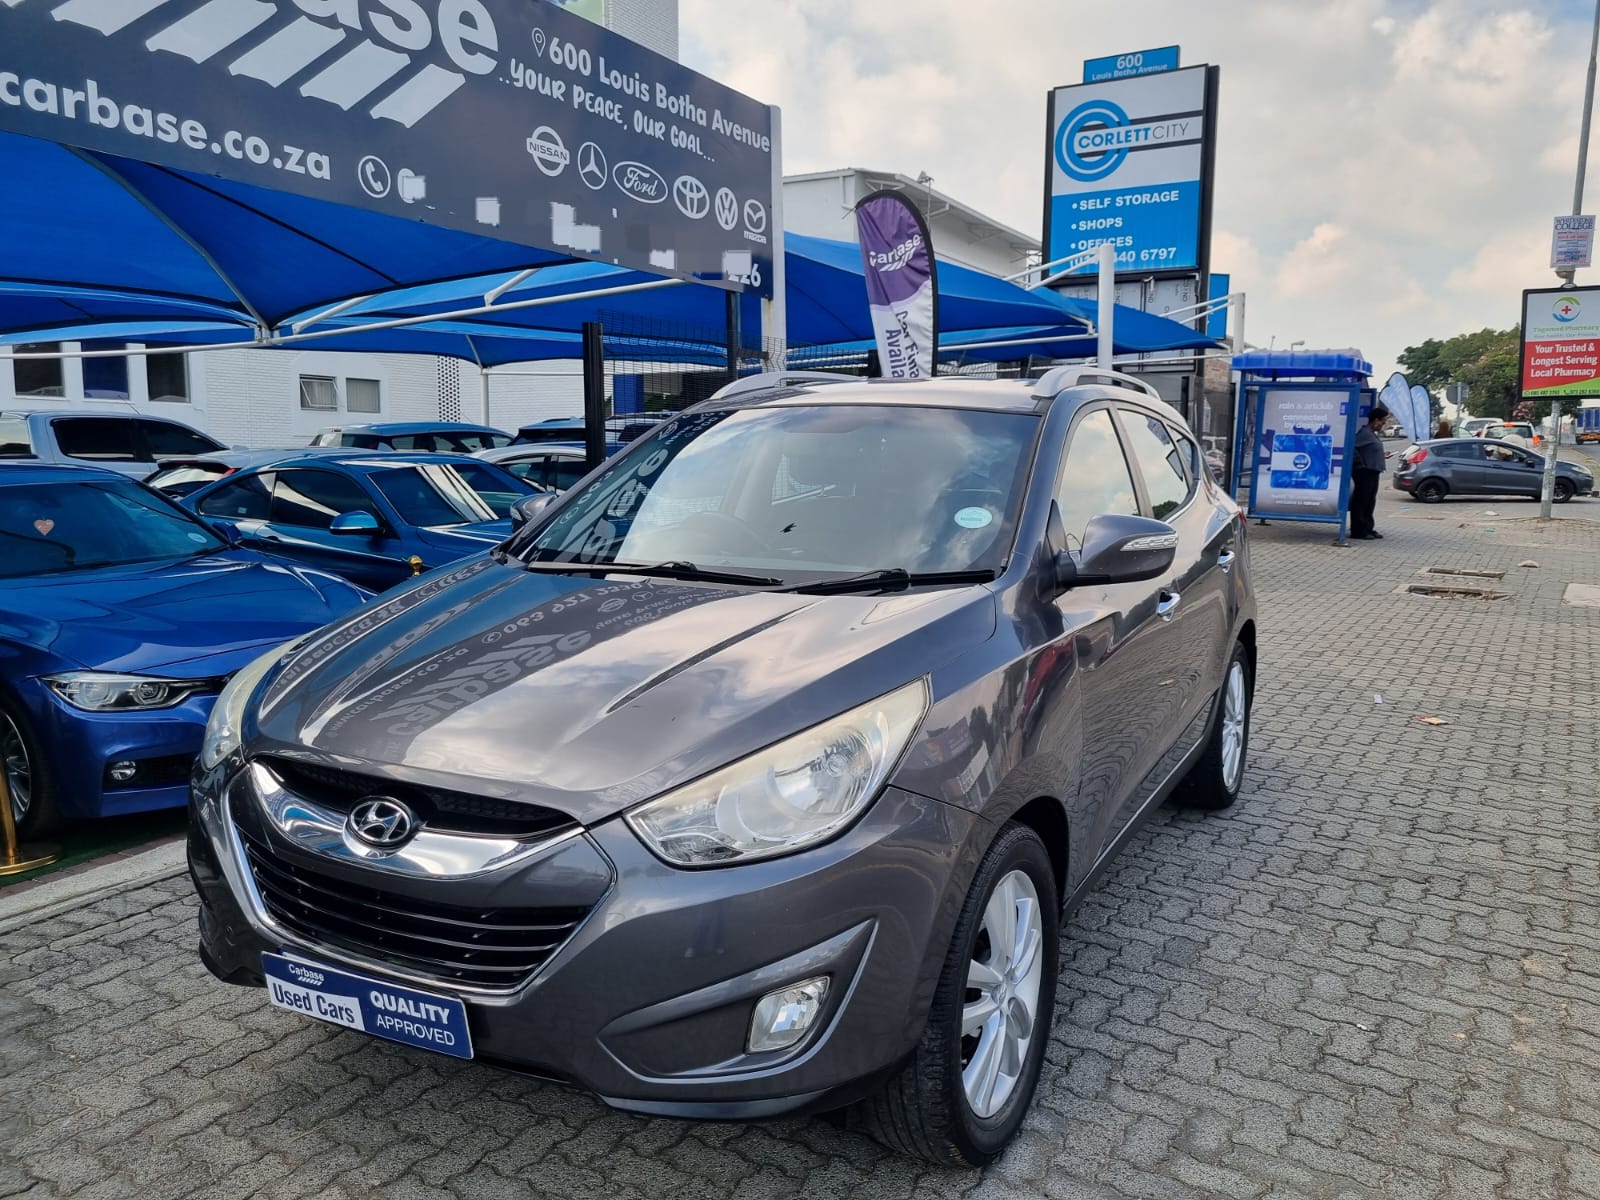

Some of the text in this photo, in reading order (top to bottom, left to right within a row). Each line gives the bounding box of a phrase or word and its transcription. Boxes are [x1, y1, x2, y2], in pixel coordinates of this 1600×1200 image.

[1116, 53, 1143, 69] 600
[1091, 63, 1168, 81] Louis Botha Avenue
[549, 36, 771, 153] 600 Louis Botha Avenue
[573, 83, 629, 131] PEACE,
[633, 109, 667, 142] OUR
[528, 140, 569, 162] NISSAN
[622, 166, 660, 198] Ford
[1079, 190, 1180, 211] SELF STORAGE
[1078, 217, 1123, 231] SHOPS
[1140, 247, 1177, 261] 6797
[1535, 342, 1595, 354] Your Trusted &
[1530, 354, 1598, 367] Longest Serving
[1530, 367, 1596, 378] Local Pharmacy
[1282, 414, 1328, 422] connected
[288, 963, 325, 982] Carbase
[272, 982, 356, 1025] Used Cars
[369, 990, 450, 1025] QUALITY
[376, 1013, 456, 1047] APPROVED
